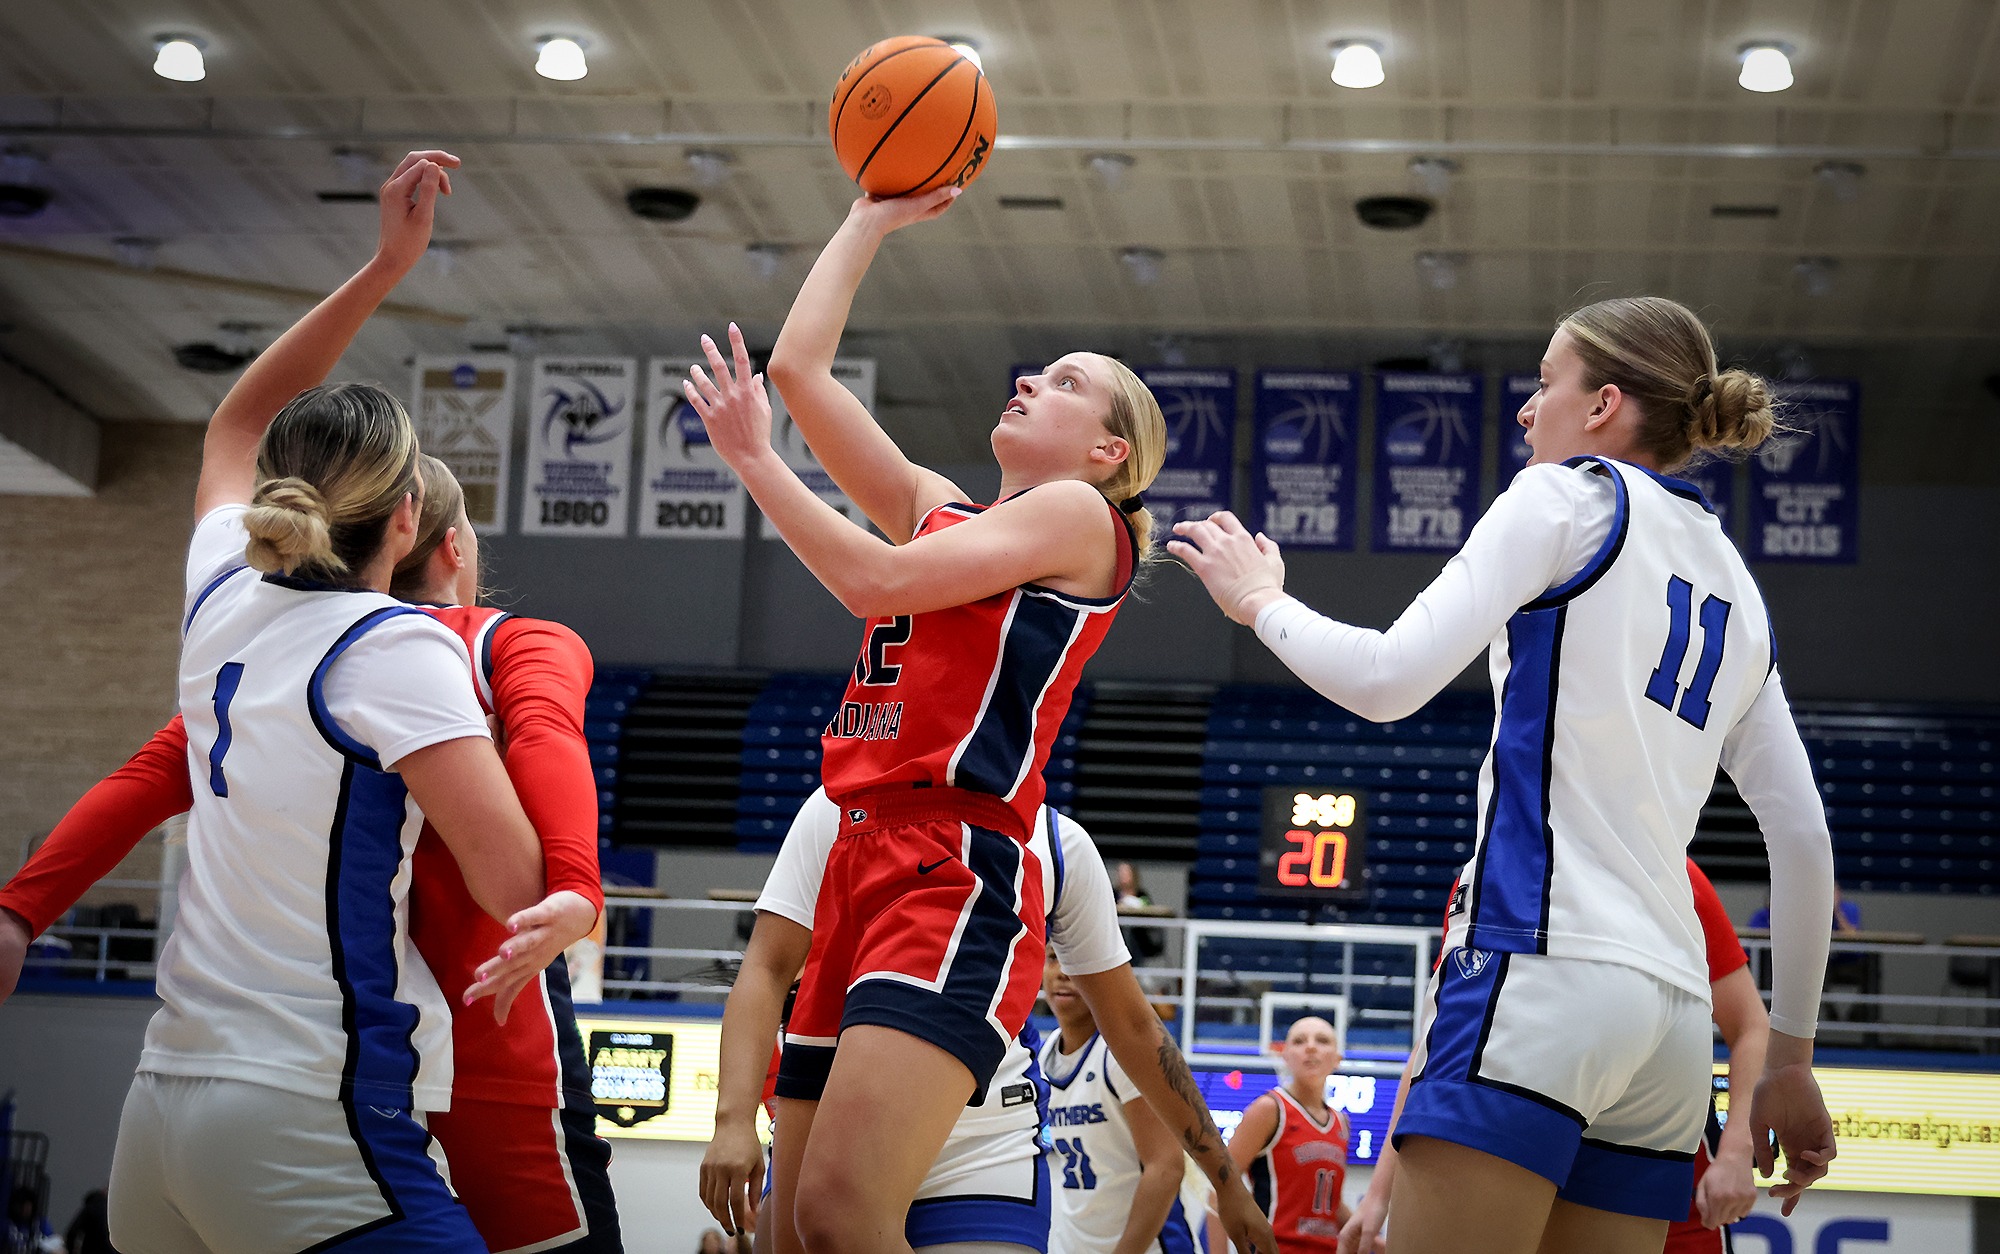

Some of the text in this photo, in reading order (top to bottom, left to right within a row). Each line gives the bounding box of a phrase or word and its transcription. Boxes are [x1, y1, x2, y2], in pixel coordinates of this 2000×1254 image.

[951, 134, 989, 188] NCA
[541, 501, 609, 528] 1980
[657, 502, 727, 529] 2001
[855, 614, 912, 687] 2
[1644, 573, 1732, 732] 11
[208, 661, 245, 799] 1
[822, 701, 903, 741] NDIANA
[1277, 829, 1348, 888] 20
[1056, 1138, 1097, 1189] 21
